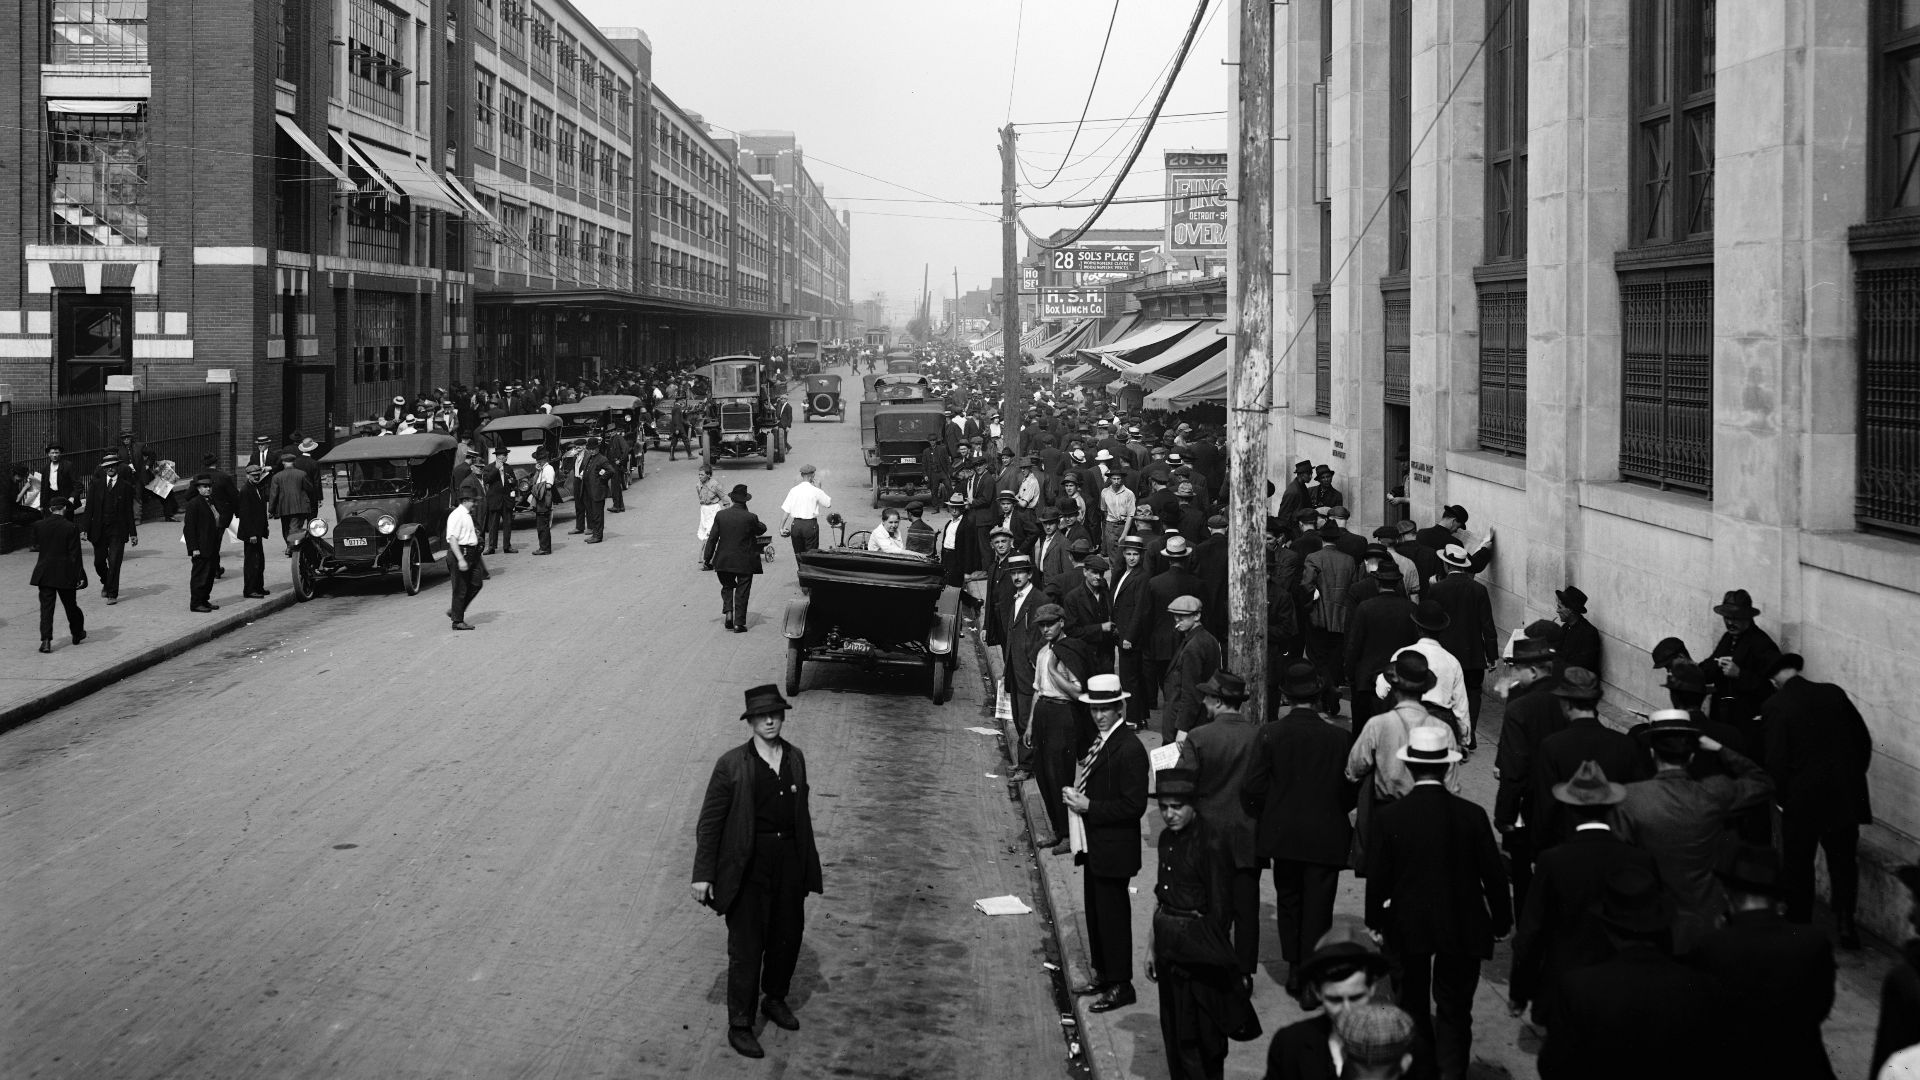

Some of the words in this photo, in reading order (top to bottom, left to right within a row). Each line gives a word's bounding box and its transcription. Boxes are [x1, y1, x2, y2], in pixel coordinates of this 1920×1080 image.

[1055, 252, 1074, 269] 28
[1078, 252, 1101, 261] SOL'S
[1105, 253, 1135, 262] PLACE
[1025, 279, 1039, 288] SE
[1045, 304, 1060, 314] BOX
[1062, 304, 1088, 314] LUNCH
[1090, 303, 1104, 314] CO.
